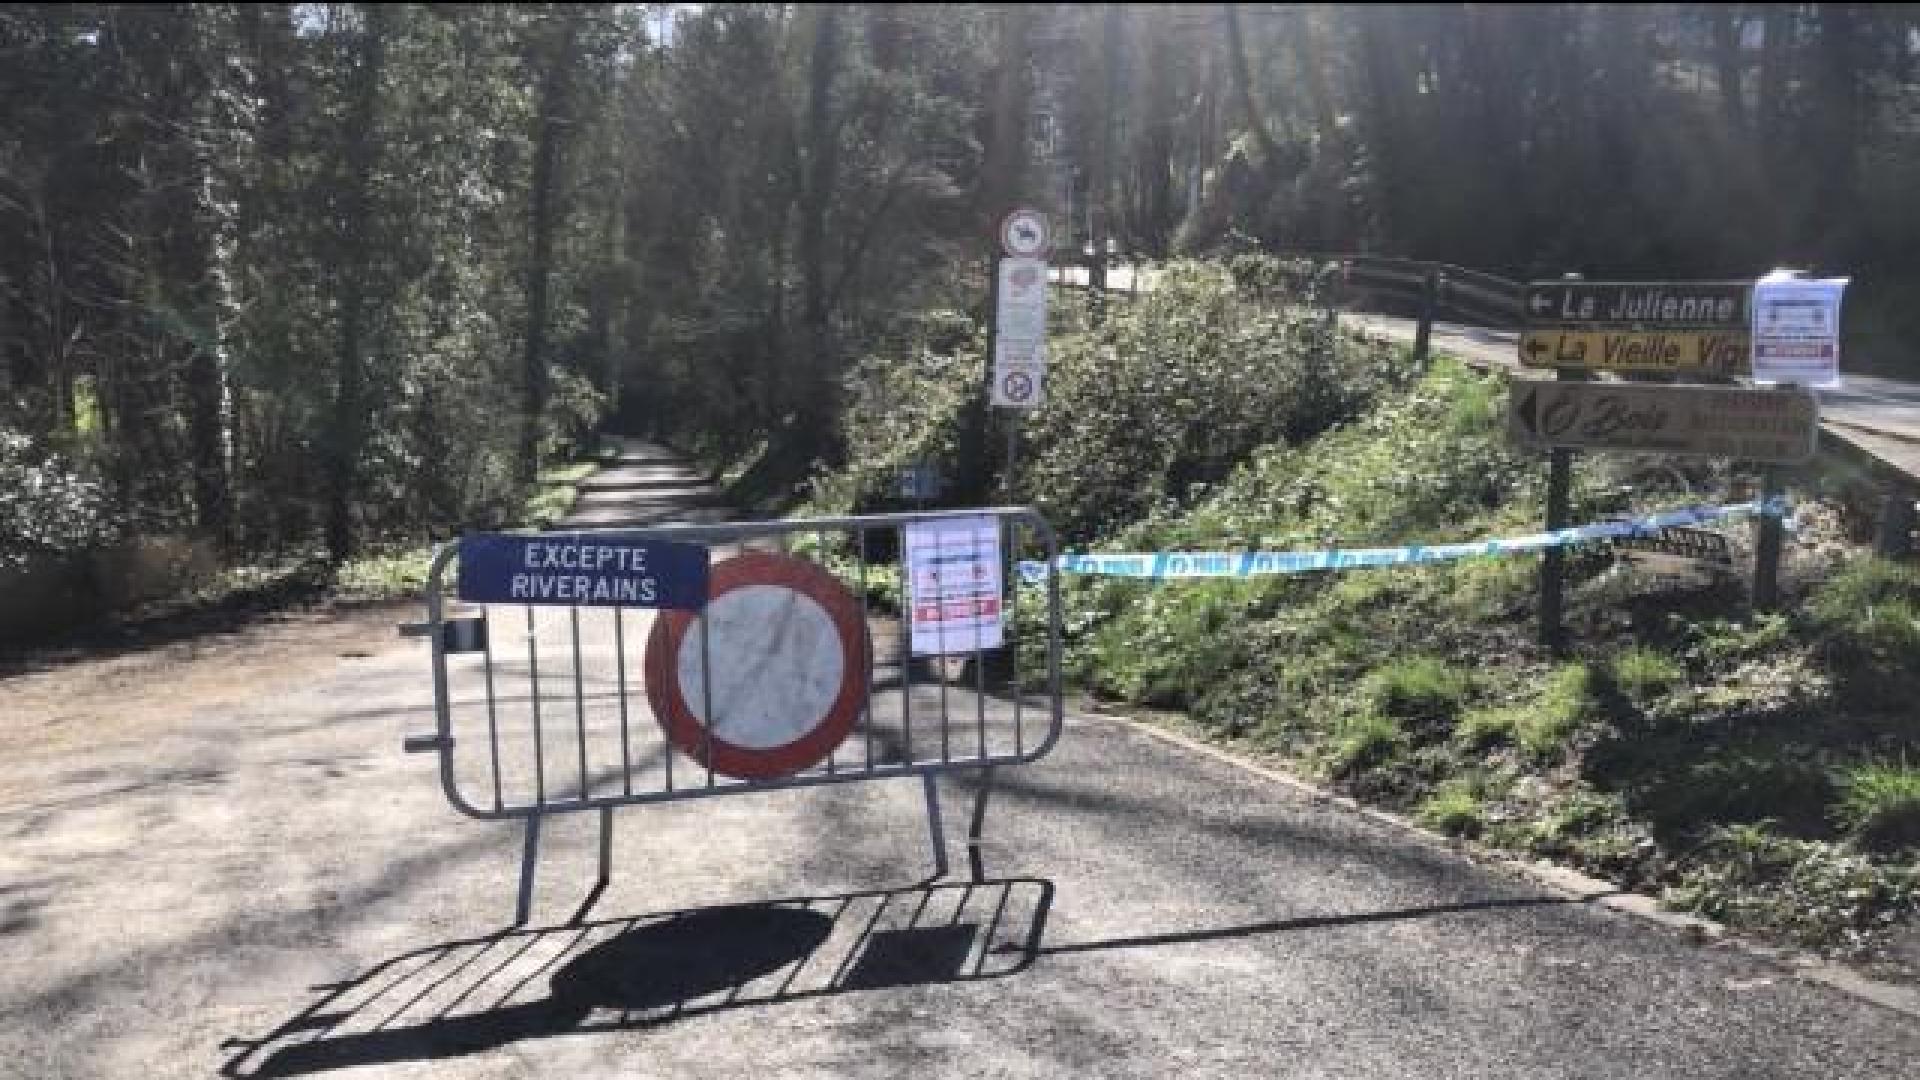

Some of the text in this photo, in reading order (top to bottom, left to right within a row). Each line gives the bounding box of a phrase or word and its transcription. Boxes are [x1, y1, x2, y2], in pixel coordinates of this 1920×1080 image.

[1561, 287, 1735, 320] La Julienne
[1556, 334, 1588, 362] La
[1603, 335, 1682, 367] Vieille
[525, 542, 649, 571] EXCEPTE
[511, 572, 657, 602] RIVERAINS
